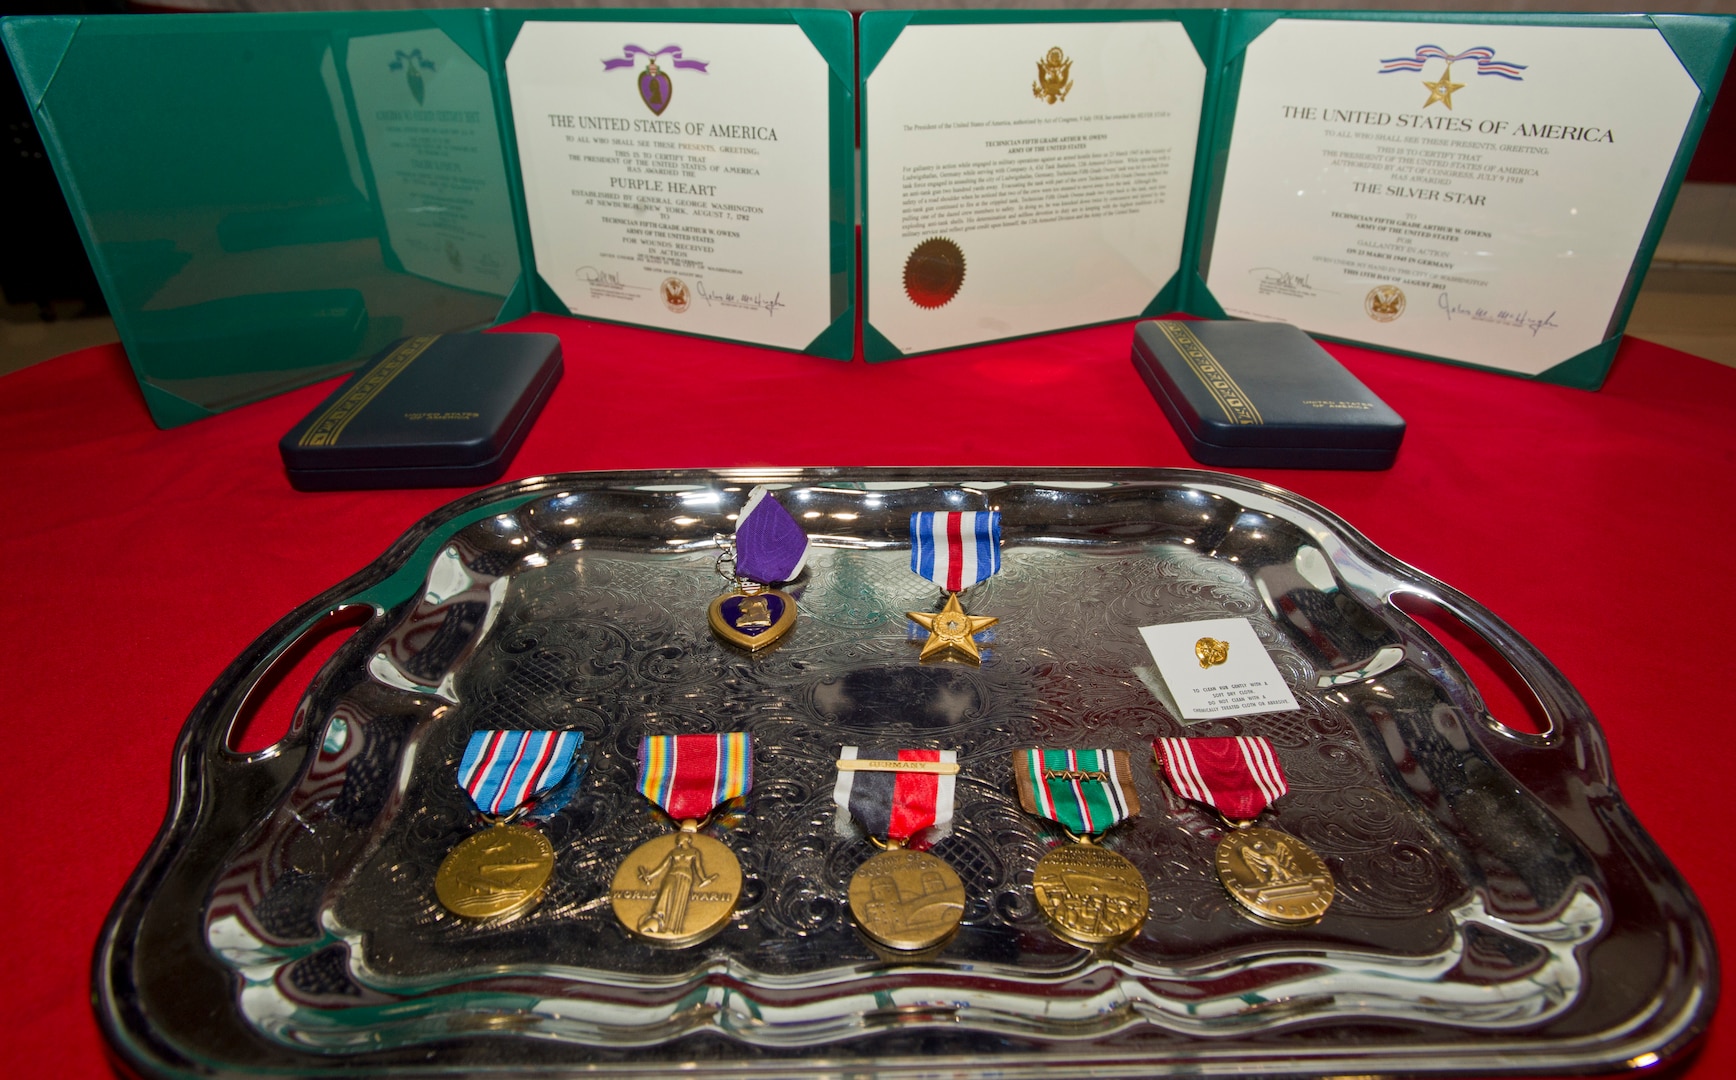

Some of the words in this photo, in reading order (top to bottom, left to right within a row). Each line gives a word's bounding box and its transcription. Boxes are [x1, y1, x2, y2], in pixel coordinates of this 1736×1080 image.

[548, 114, 575, 128] THE
[579, 116, 630, 131] UNITED
[633, 119, 681, 134] STATES
[685, 122, 705, 136] OF
[709, 124, 778, 140] AMERICA
[1282, 105, 1317, 119] THE
[1323, 108, 1391, 125] UNITED
[1396, 113, 1473, 131] STATES
[1478, 119, 1509, 133] OF
[1512, 122, 1614, 143] AMERICA
[610, 177, 663, 191] PURPLE
[667, 181, 716, 196] HEART
[1353, 181, 1382, 194] THE
[1385, 185, 1440, 200] SILVER
[1443, 191, 1486, 205] STAR
[1331, 211, 1373, 221] TECHNICIAN
[1374, 217, 1395, 225] FIFTH
[1396, 219, 1421, 228] GRADE
[1423, 223, 1453, 232] ARTHUR
[1464, 229, 1492, 238] OWENS
[1404, 229, 1431, 238] UNITED
[1432, 232, 1459, 241] STATES
[869, 761, 926, 769] GERMANY
[613, 890, 658, 899] WORLD
